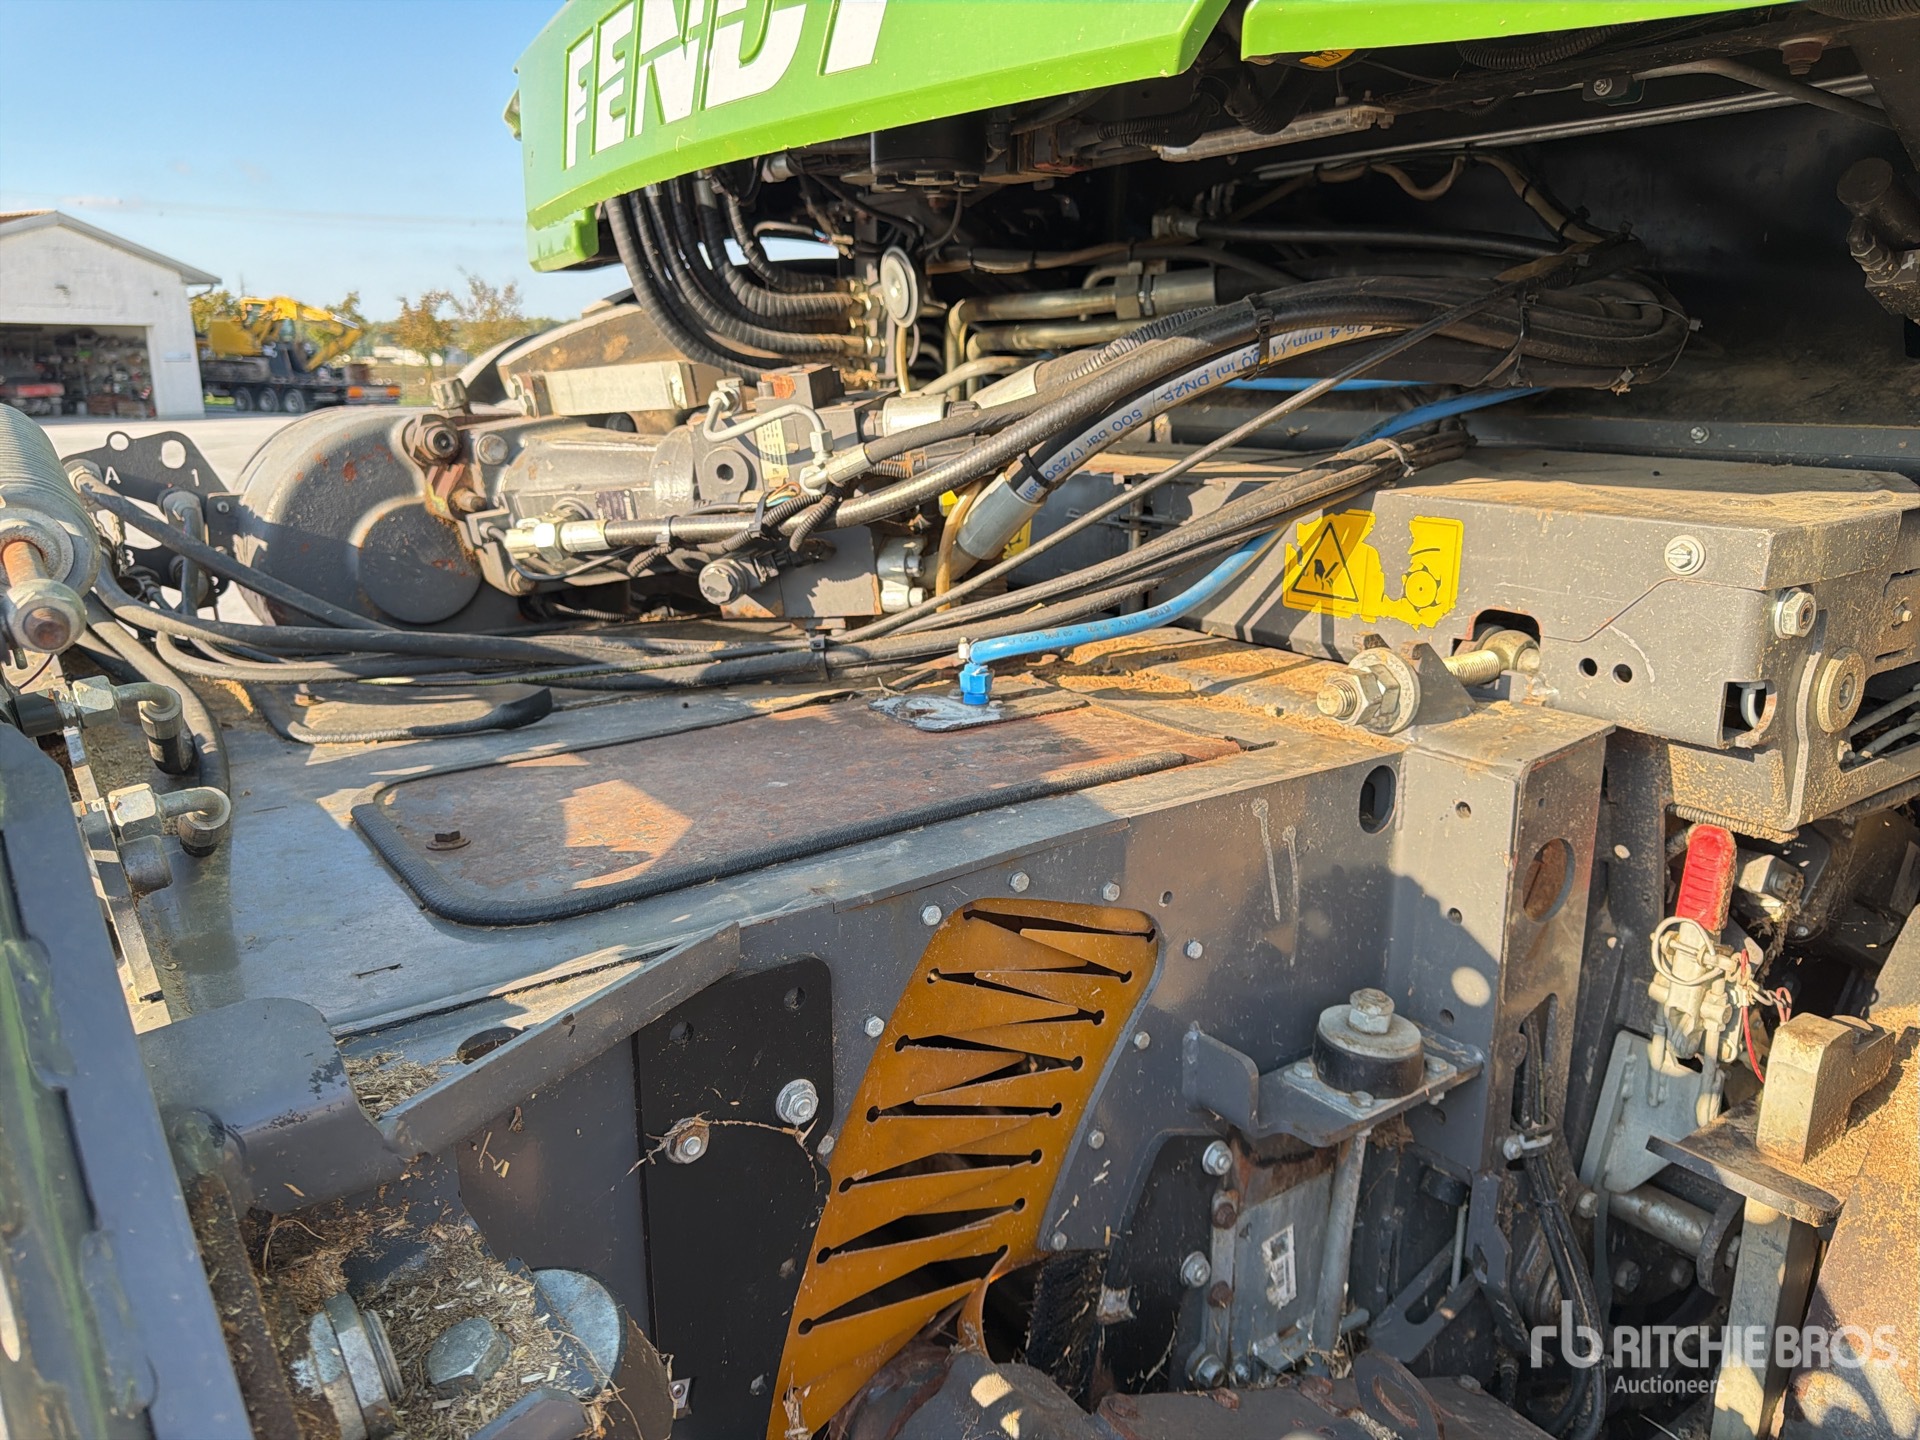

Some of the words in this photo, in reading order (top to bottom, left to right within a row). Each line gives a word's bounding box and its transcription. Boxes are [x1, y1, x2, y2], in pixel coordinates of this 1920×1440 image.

[1293, 334, 1323, 347] mm
[1216, 361, 1236, 379] in)
[1163, 372, 1210, 403] DN25
[1111, 408, 1143, 432] 500
[1086, 431, 1110, 449] bar
[1044, 446, 1086, 481] (7250
[105, 466, 121, 485] A
[191, 468, 199, 487] 1
